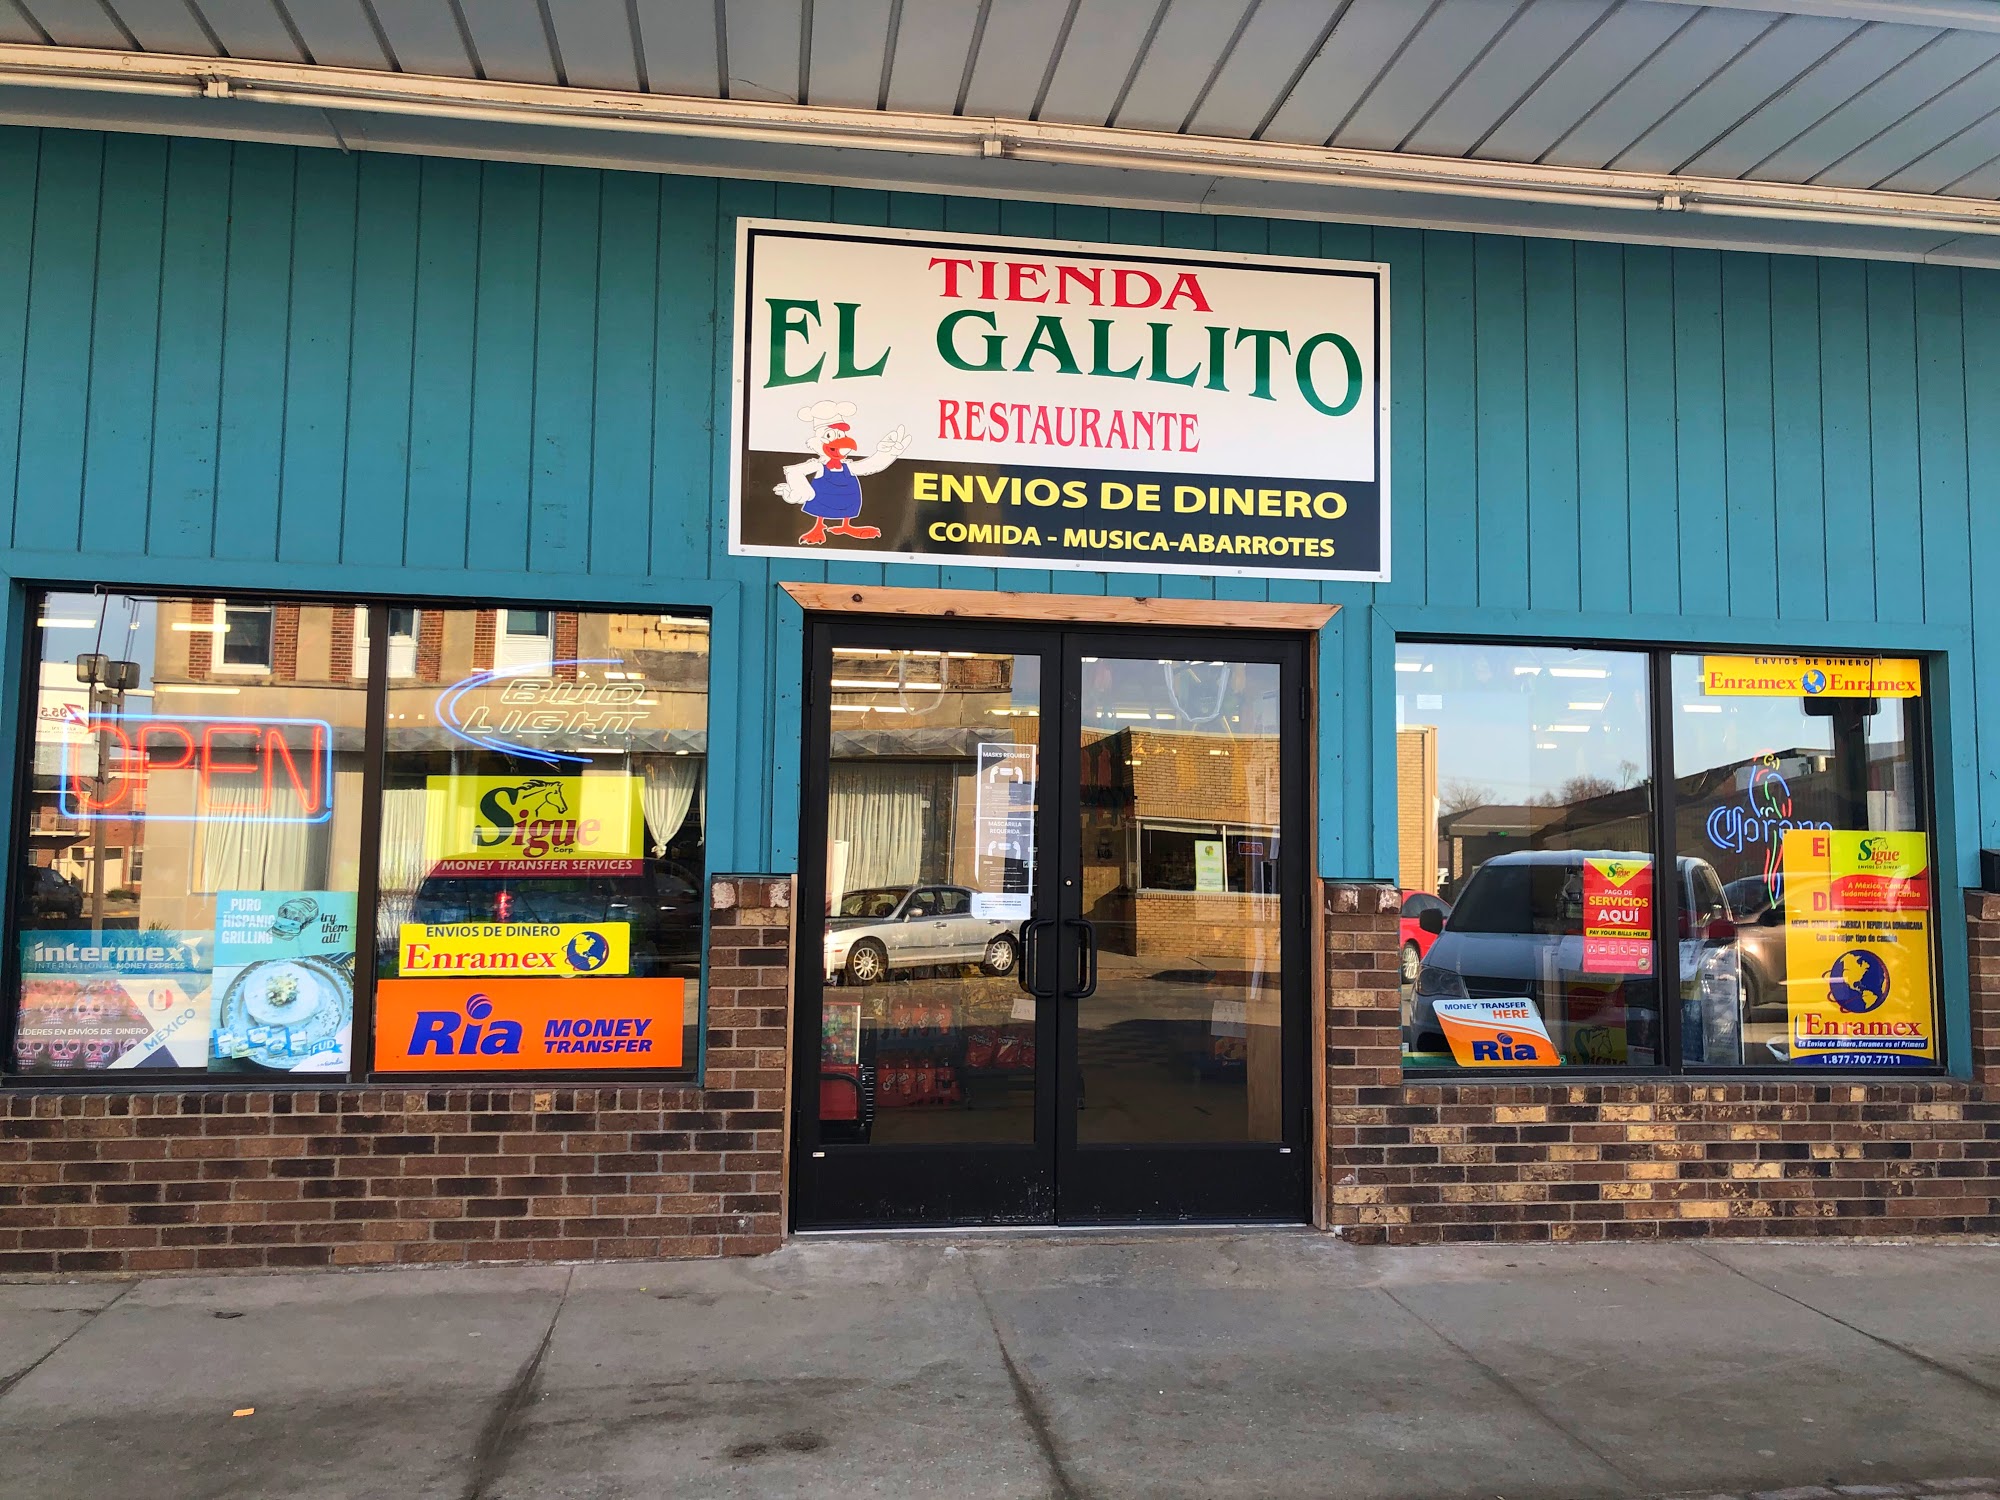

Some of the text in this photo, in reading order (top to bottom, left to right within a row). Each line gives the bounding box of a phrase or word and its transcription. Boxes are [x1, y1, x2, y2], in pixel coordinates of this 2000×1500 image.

[928, 257, 1214, 313] TIENDA
[764, 298, 1363, 416] EL GALLITO
[937, 399, 1200, 453] RESTAURANTE
[913, 472, 1347, 519] ENVIOS DE DINERO
[928, 522, 1042, 546] COMIDA
[1754, 657, 1870, 667] ENVIOS DE DINERO
[1708, 671, 1916, 691] Enramex Enramex
[500, 678, 645, 706] BUD
[461, 706, 651, 735] LIGHT
[72, 722, 323, 813] OPEN
[473, 786, 601, 859] Sigue
[1857, 838, 1900, 865] Sigue
[441, 860, 633, 871] MONEY TRANSFER SERVICES
[230, 898, 262, 911] PURO
[1588, 896, 1649, 907] SERVICIOS
[320, 913, 337, 925] try
[1597, 908, 1639, 924] AQUÍ
[222, 931, 273, 944] GRILLING
[322, 923, 348, 933] them
[426, 925, 561, 938] ENVIOS DE DINERO
[34, 941, 185, 962] intermex
[403, 943, 558, 970] Enramex
[1444, 1001, 1527, 1011] MONEY TRANSFER
[1492, 1009, 1530, 1019] HERE
[54, 1028, 66, 1036] EN
[100, 1028, 112, 1036] DE
[115, 1027, 148, 1035] DINERO
[407, 993, 523, 1056] Ria
[544, 1018, 653, 1038] MONEY
[1804, 1013, 1922, 1036] Enramex
[312, 1039, 335, 1054] FUD
[544, 1039, 653, 1054] TRANSFER
[1471, 1032, 1539, 1061] Ria
[1822, 1055, 1901, 1064] 1.877.707.7711
